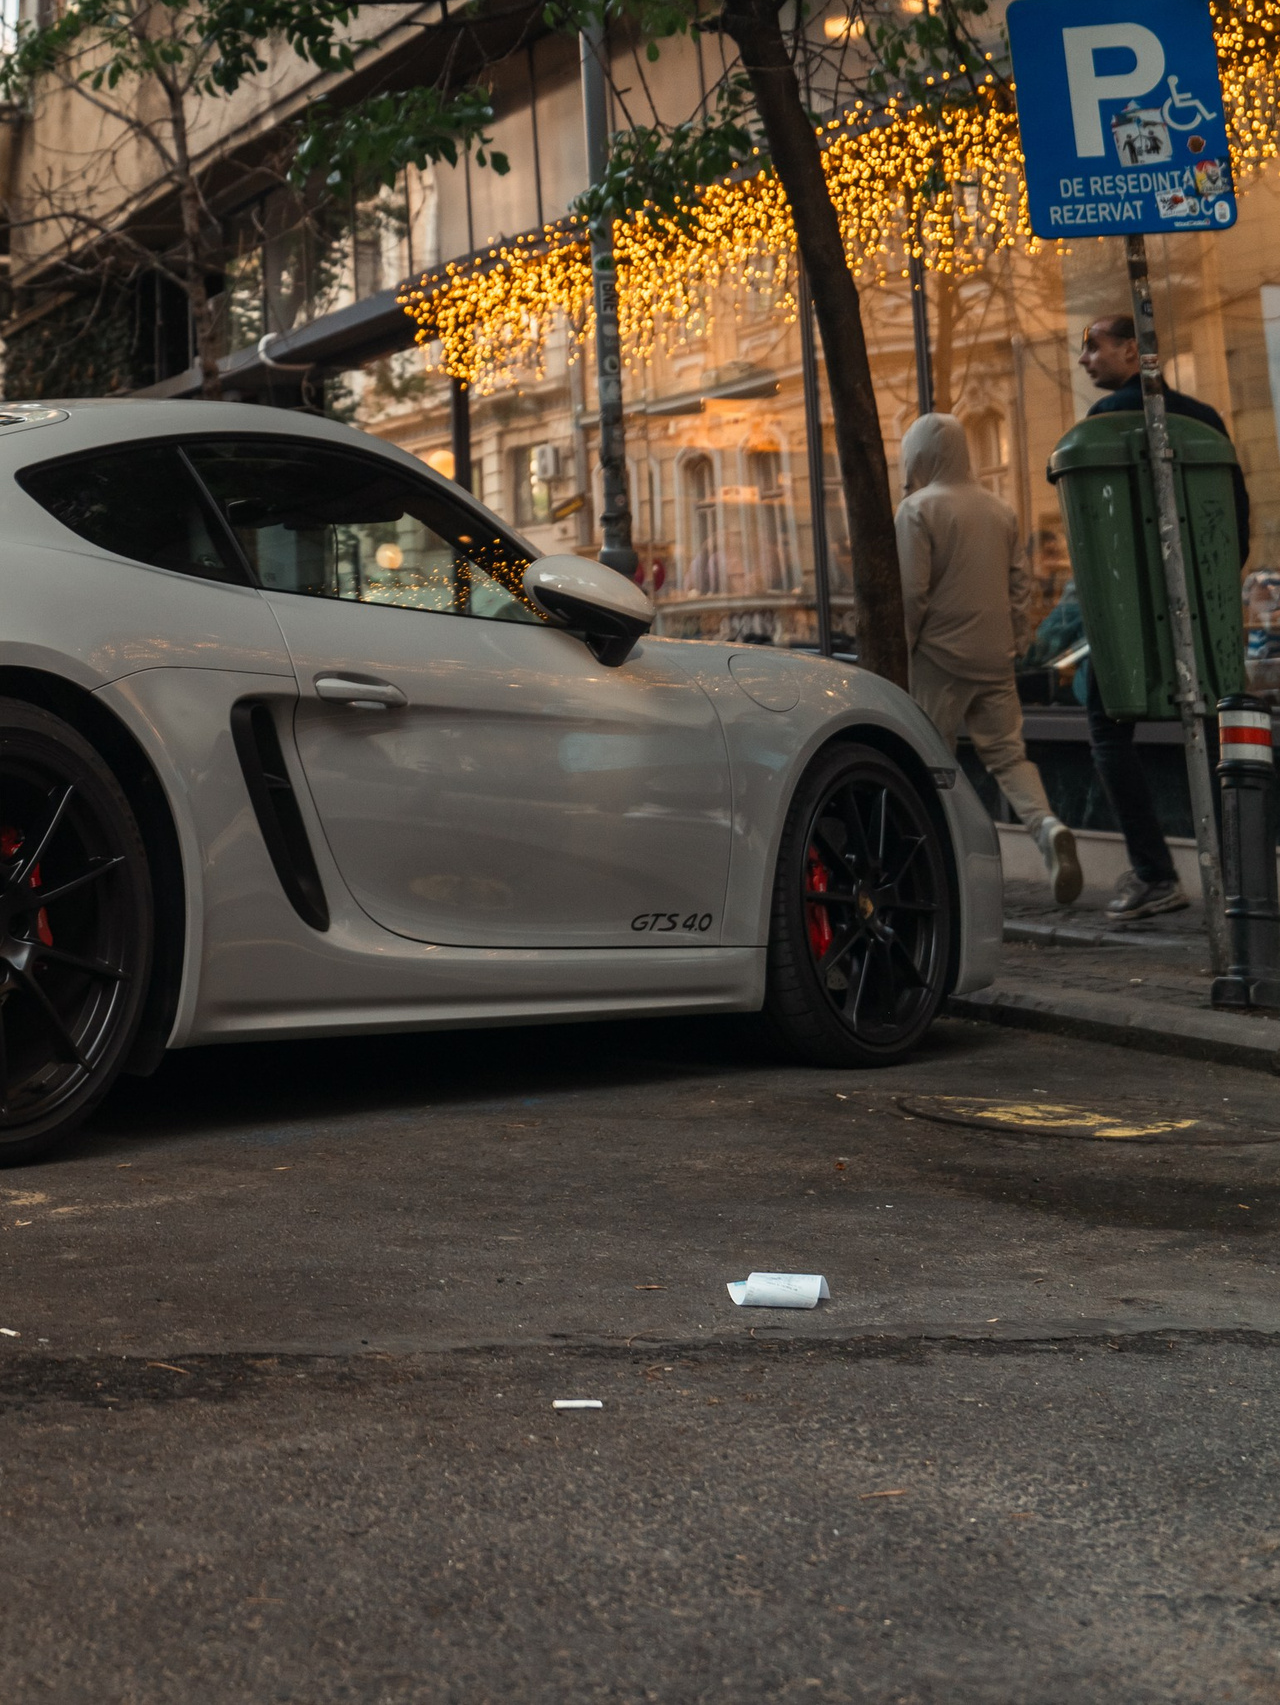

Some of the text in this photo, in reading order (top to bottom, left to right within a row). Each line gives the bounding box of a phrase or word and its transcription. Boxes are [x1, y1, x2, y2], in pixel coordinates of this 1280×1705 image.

[1062, 21, 1165, 158] P
[1060, 178, 1085, 198] DE
[1049, 200, 1143, 225] REZERVAT
[631, 912, 713, 932] GTS 4.0
